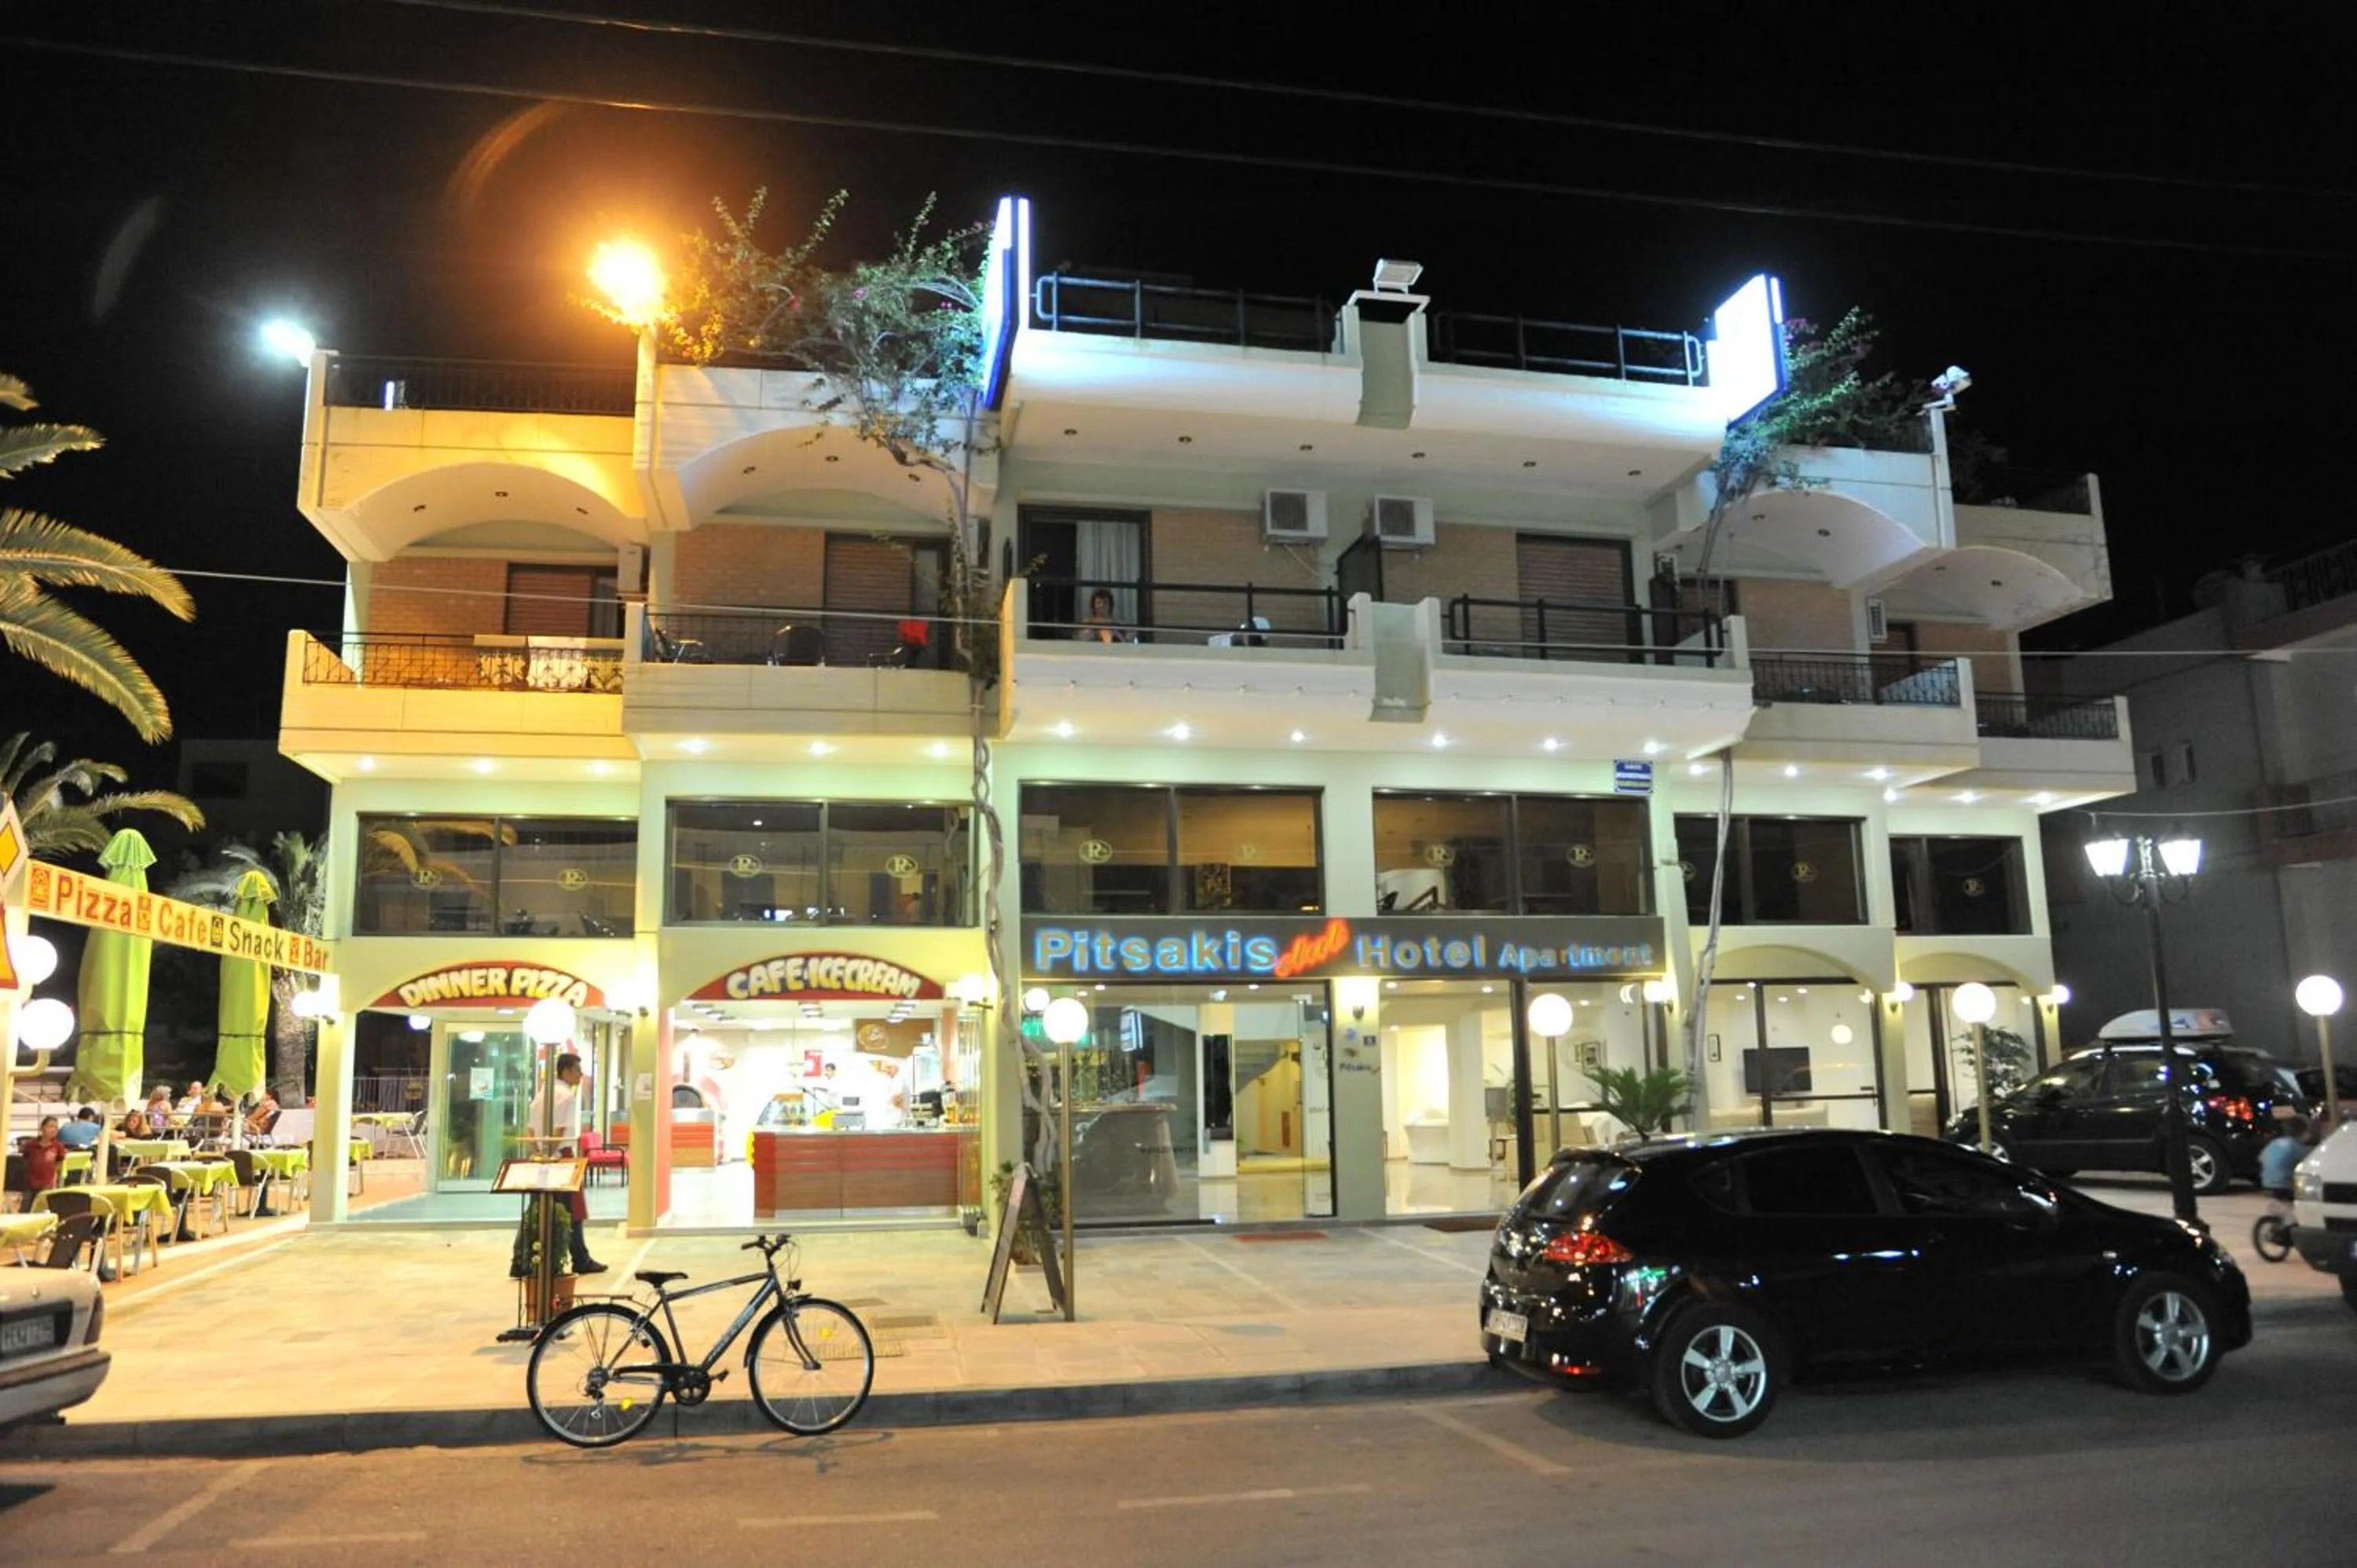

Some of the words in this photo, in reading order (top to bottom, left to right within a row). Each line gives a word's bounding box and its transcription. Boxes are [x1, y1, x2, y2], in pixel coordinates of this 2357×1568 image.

[56, 874, 132, 929] Pizza
[159, 901, 207, 947] Cafe
[229, 921, 284, 962] Snack
[303, 936, 329, 970] Bar
[1034, 929, 1277, 973] Pitsakis
[1356, 933, 1486, 969] Hotel
[1497, 942, 1654, 973] Apartment
[398, 967, 508, 1008] DINNER
[511, 967, 589, 1008] PIZZA
